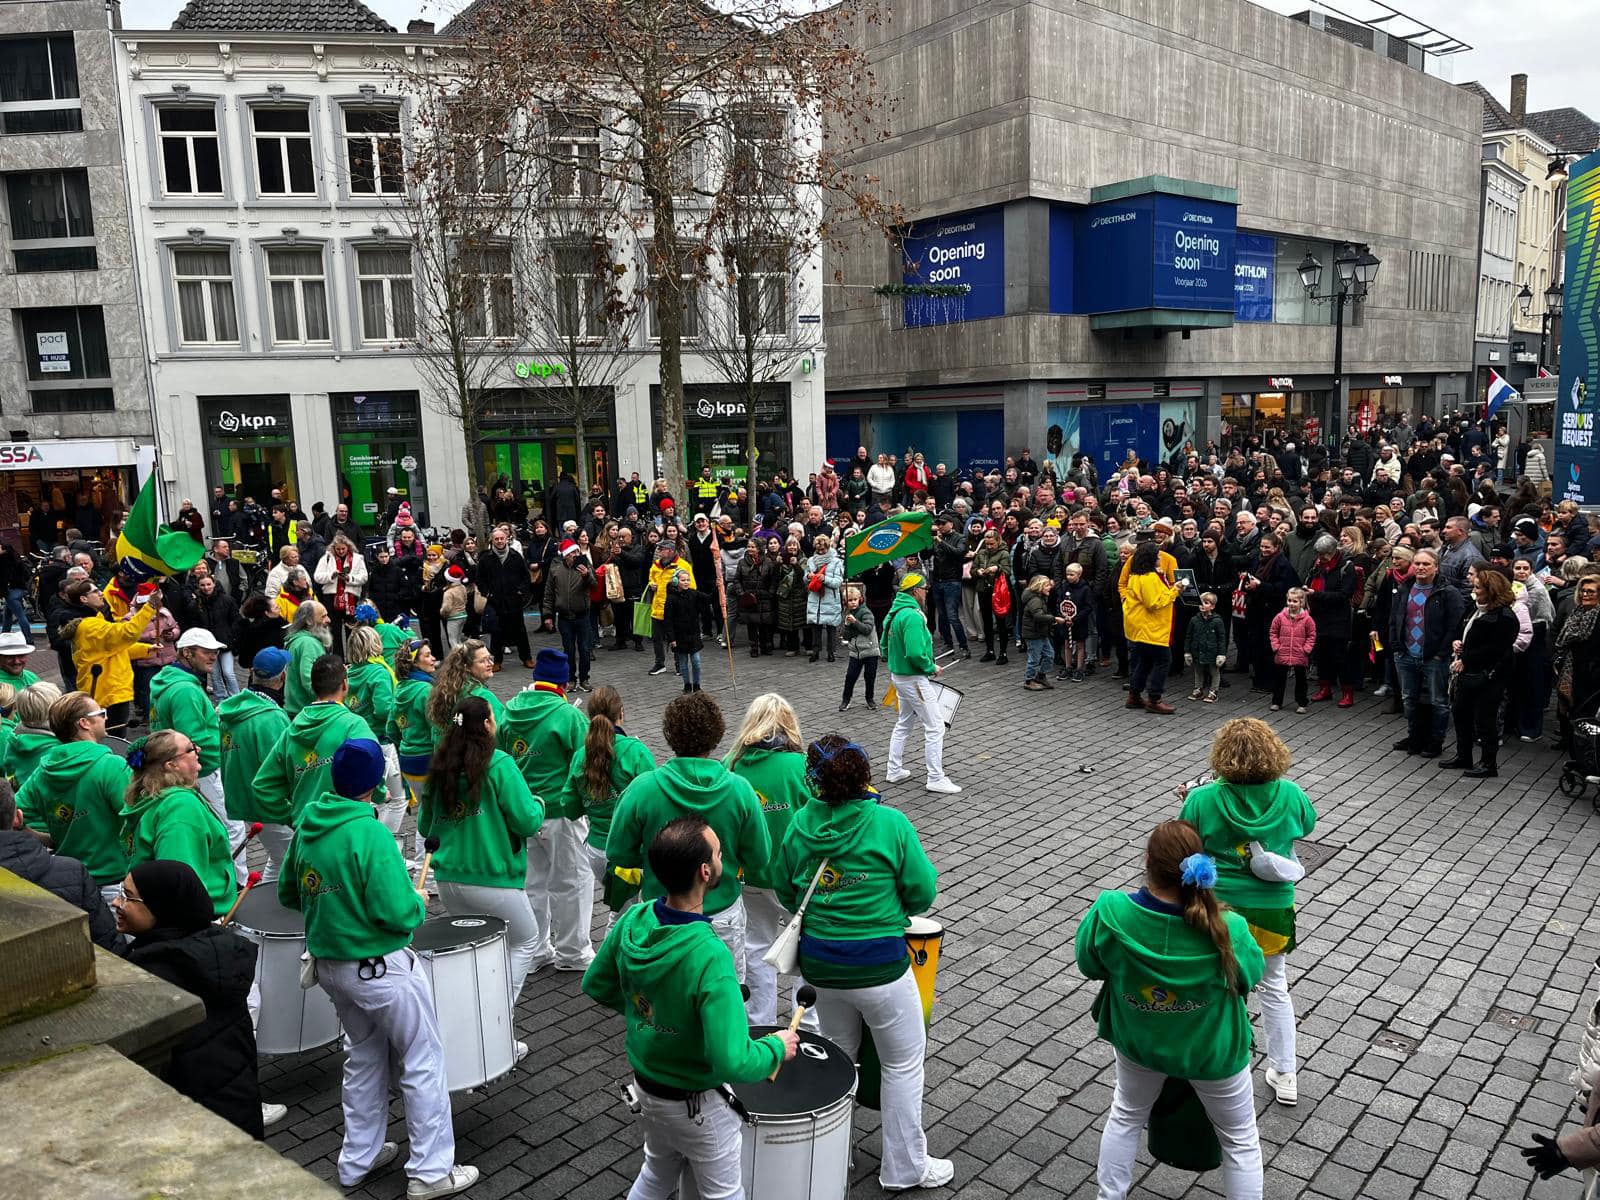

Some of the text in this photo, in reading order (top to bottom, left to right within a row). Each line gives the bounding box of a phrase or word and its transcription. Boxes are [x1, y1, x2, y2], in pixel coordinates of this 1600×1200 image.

[1100, 211, 1137, 225] DECATHLON
[1188, 213, 1213, 224] DECATHLON
[944, 222, 976, 235] DECATHLON
[1175, 230, 1219, 256] Opening
[929, 241, 985, 265] Opening
[1174, 256, 1200, 270] soon
[929, 265, 961, 283] soon
[1174, 276, 1208, 288] Voorjaar 2026
[40, 334, 64, 346] pact
[530, 360, 565, 379] kpn
[716, 401, 746, 416] kpn
[241, 413, 276, 430] kpn
[1561, 429, 1593, 448] REQUEST
